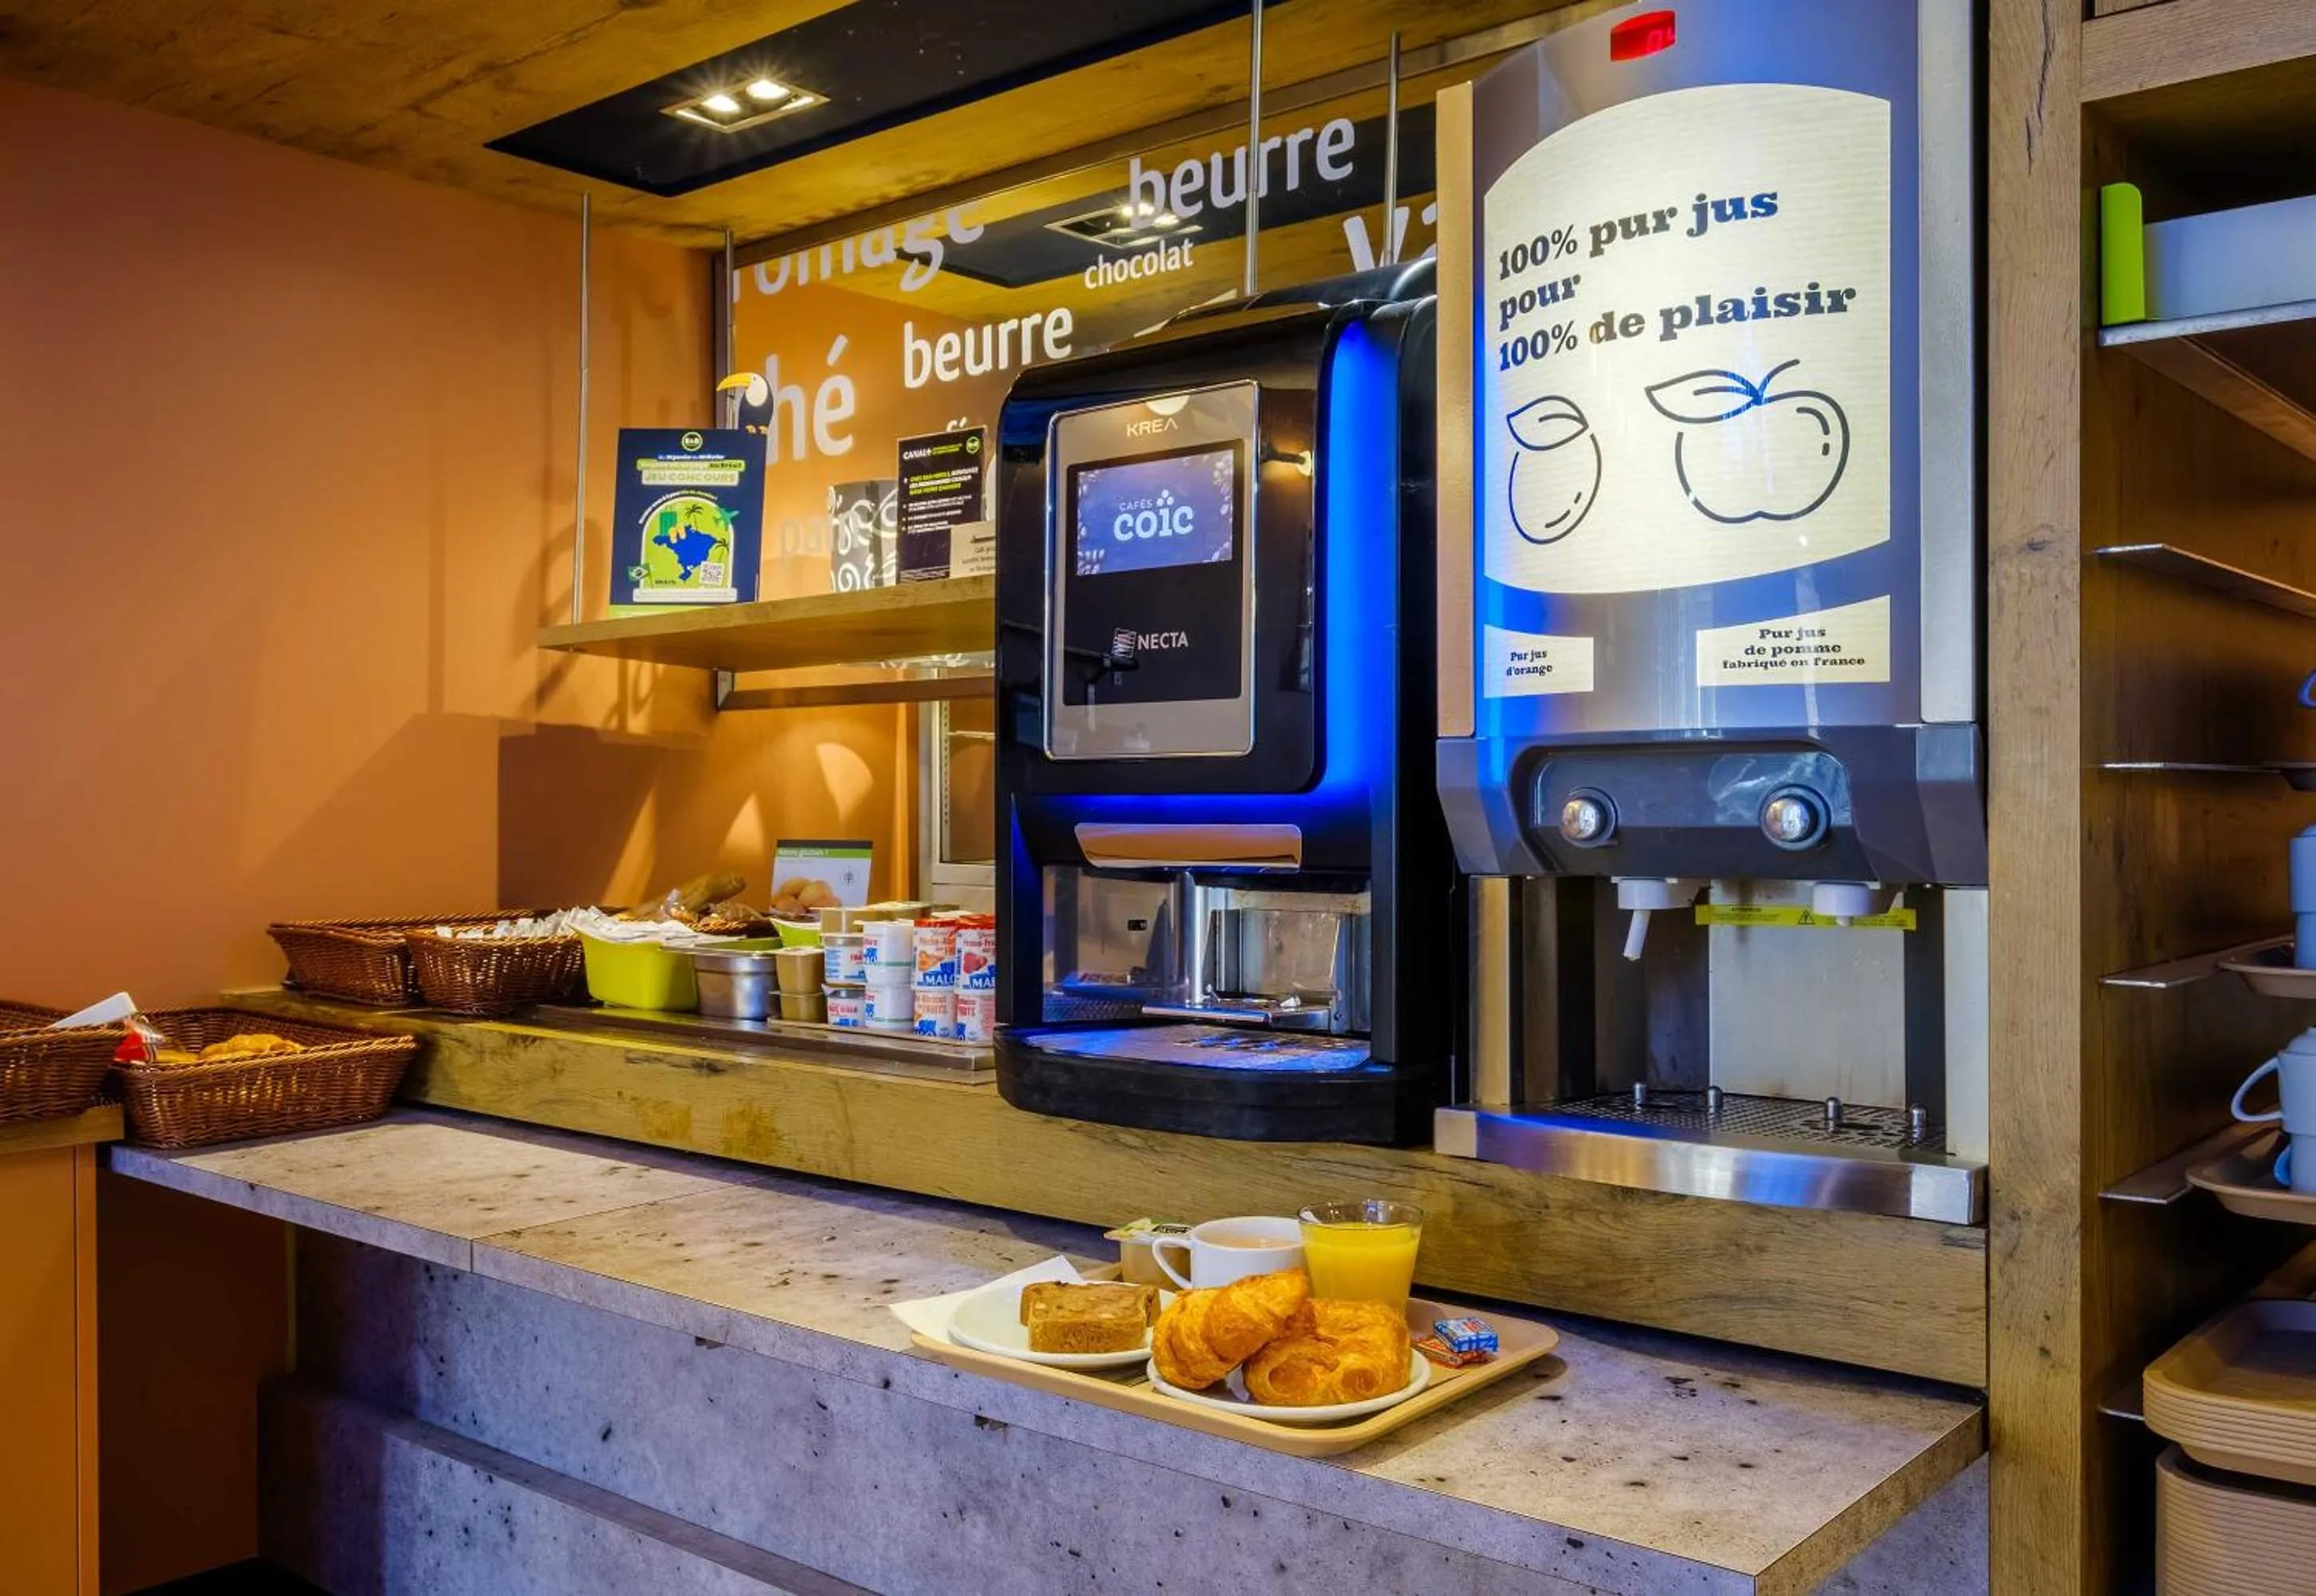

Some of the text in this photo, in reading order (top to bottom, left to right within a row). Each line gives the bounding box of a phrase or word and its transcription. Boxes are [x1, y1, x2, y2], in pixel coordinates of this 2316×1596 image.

[1129, 117, 1355, 230] beurre
[1498, 192, 1779, 280] 100% pur jus
[1084, 238, 1193, 290] chocolat
[1498, 274, 1581, 331] pour
[1498, 282, 1857, 371] 100% de plaisir
[903, 307, 1073, 389] beurre
[736, 334, 855, 465] hé
[1138, 632, 1188, 650] NECTA
[1510, 649, 1548, 663] Pur jus
[1744, 645, 1842, 659] de pomme
[1759, 627, 1826, 641] Pur jus
[1506, 664, 1553, 677] d'orange
[1723, 659, 1787, 671] fabriqué
